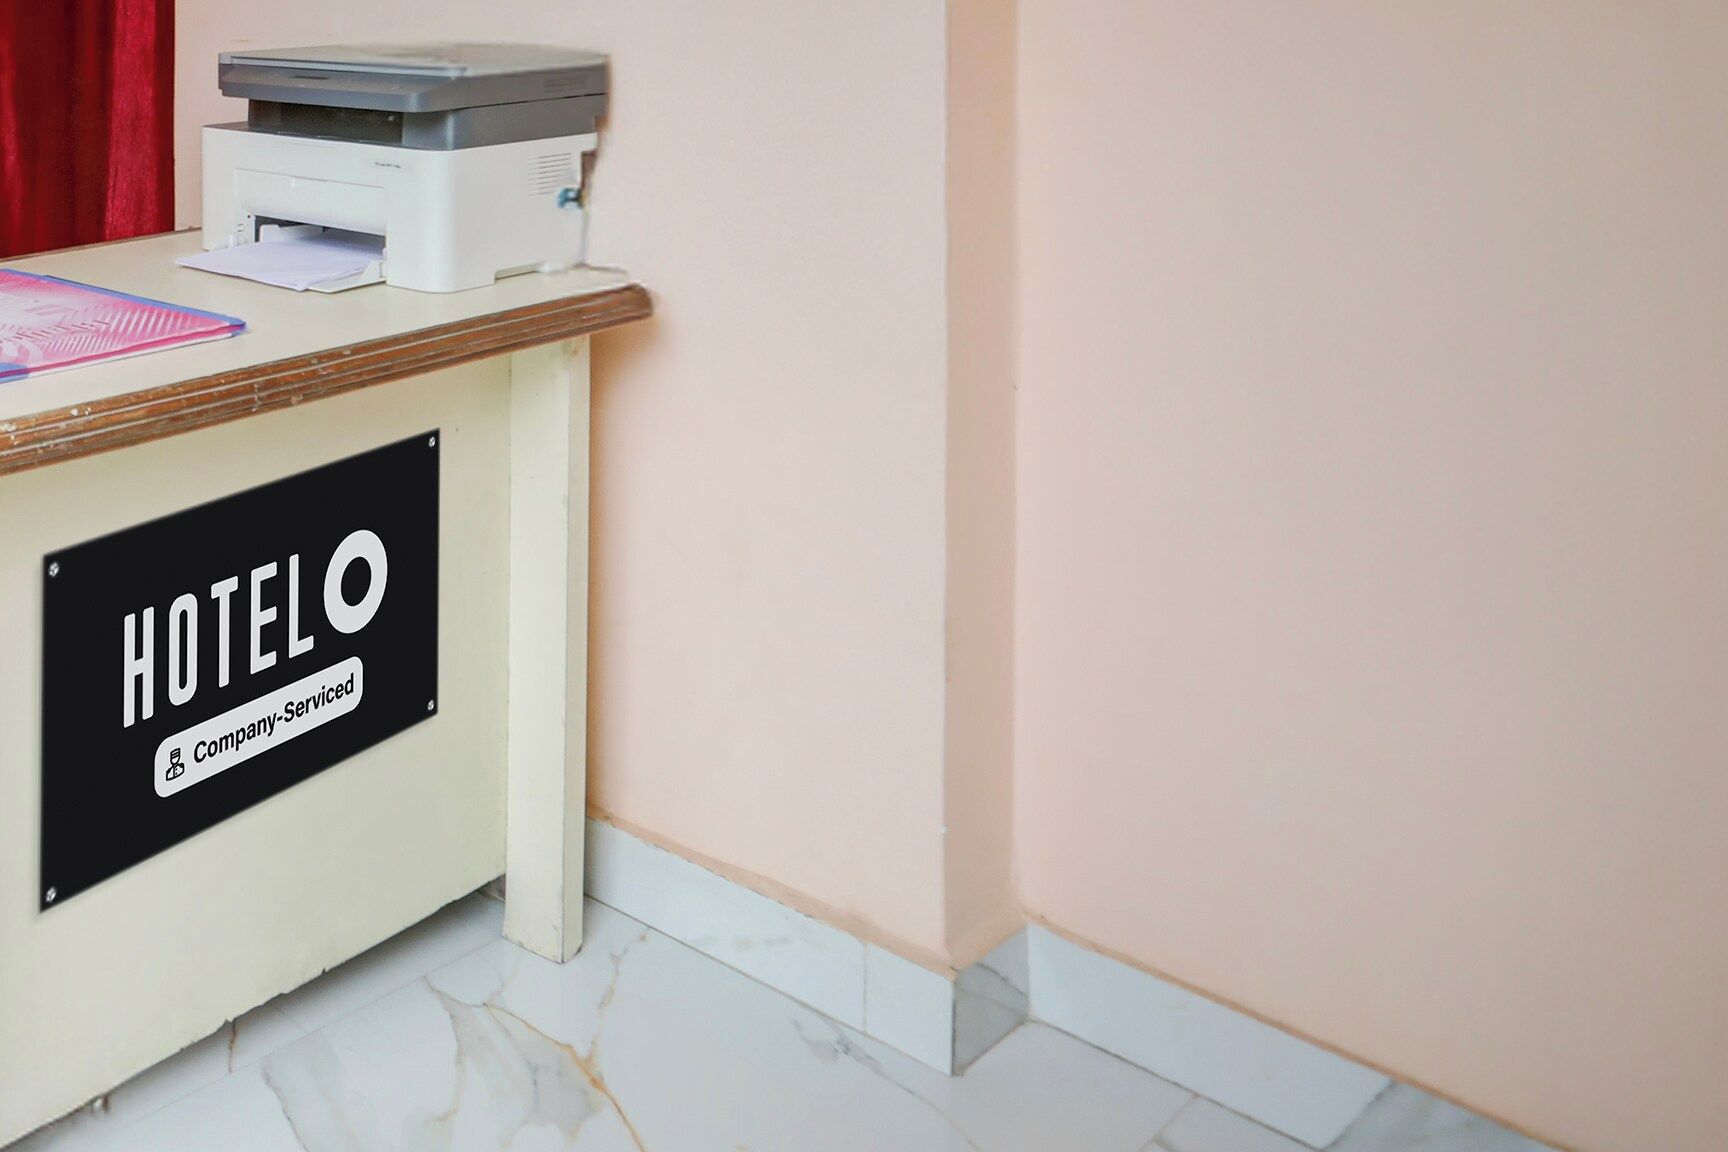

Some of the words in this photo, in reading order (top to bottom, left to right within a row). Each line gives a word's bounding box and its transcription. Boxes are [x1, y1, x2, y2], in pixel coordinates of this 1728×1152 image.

[123, 553, 315, 729] HOTEL
[323, 529, 388, 634] O
[193, 672, 355, 764] Company-Serviced
